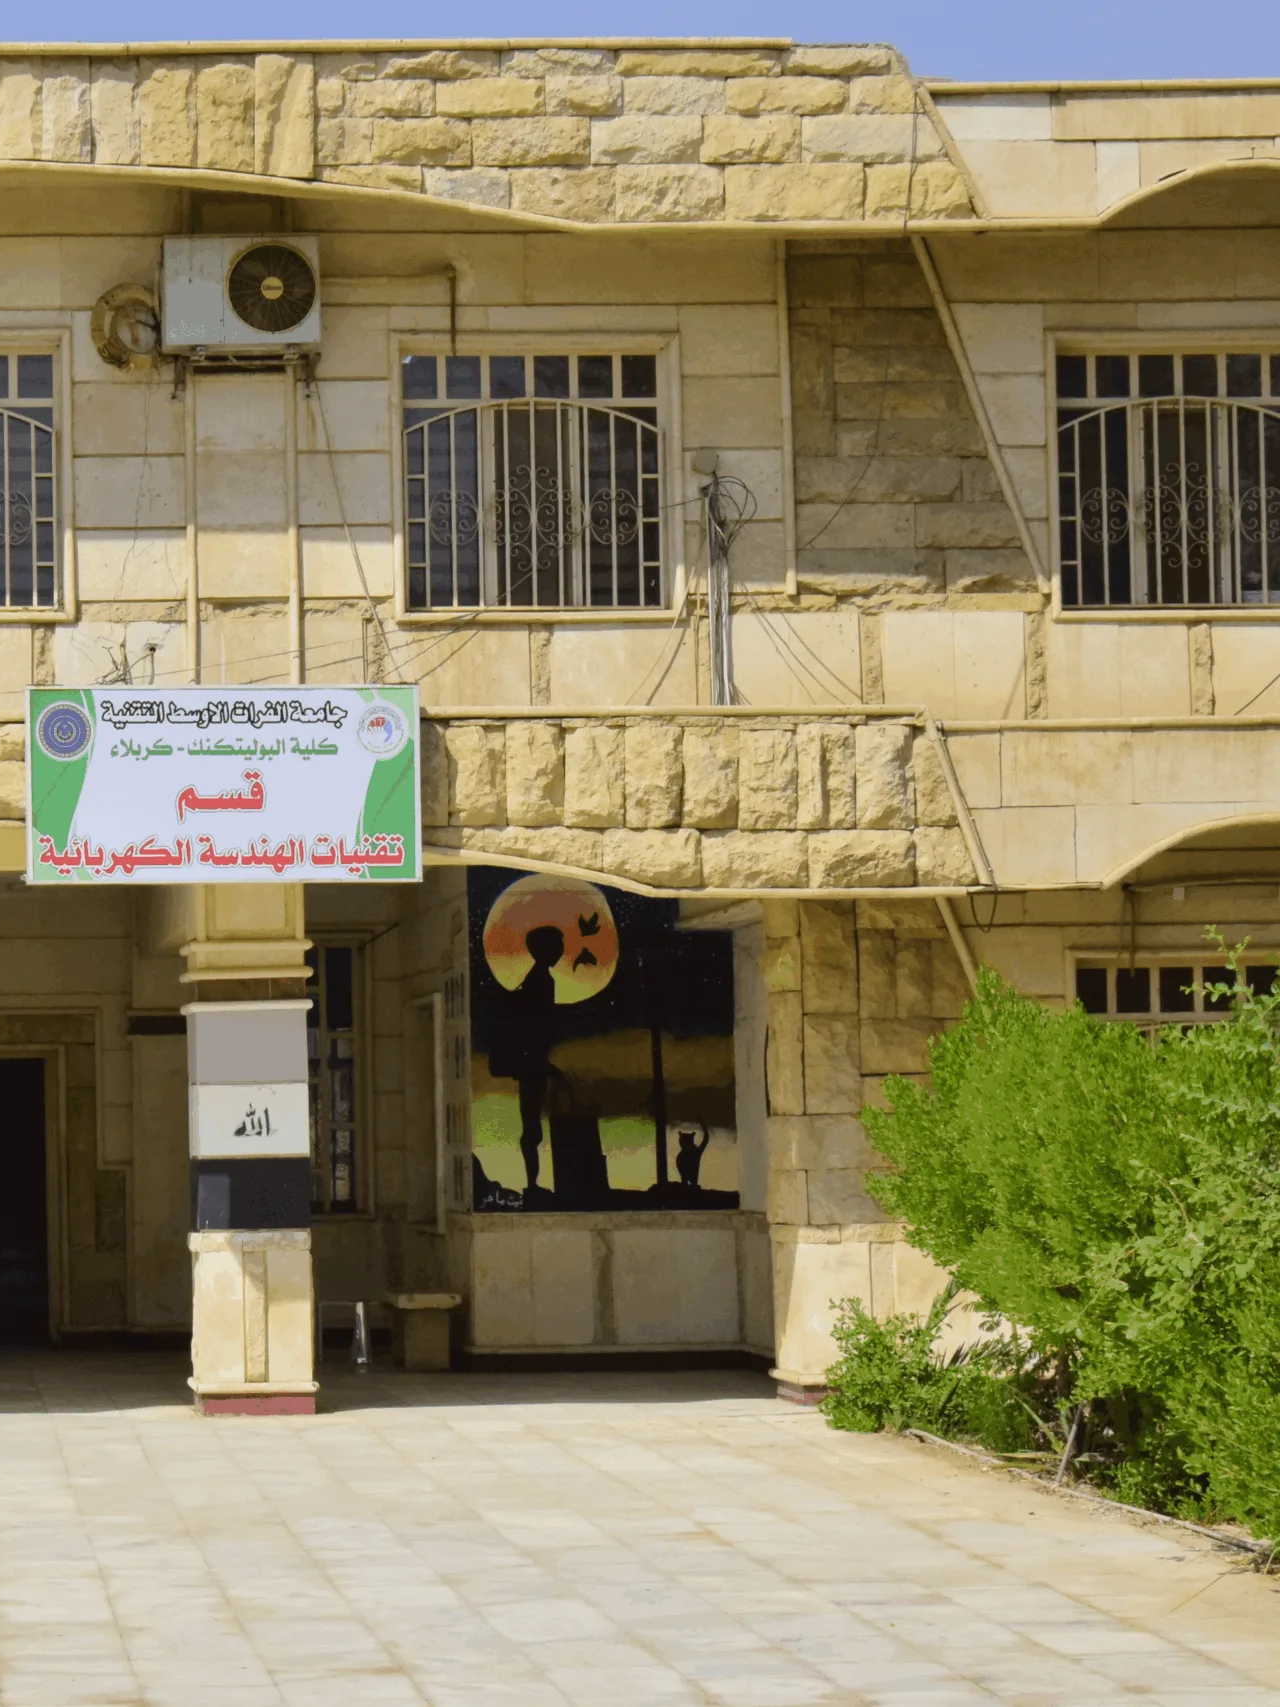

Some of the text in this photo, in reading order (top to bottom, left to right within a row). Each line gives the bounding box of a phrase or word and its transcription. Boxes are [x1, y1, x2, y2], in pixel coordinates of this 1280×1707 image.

[101, 701, 348, 729] جامعة الفرات الاوسط التقنية
[110, 738, 173, 761] كربلاء
[187, 738, 285, 761] البوليتكنك
[290, 737, 338, 761] كلية
[176, 770, 265, 822] قسم
[40, 836, 403, 874] تقنيات الهندسة الكهربائية
[234, 1102, 271, 1137] الله
